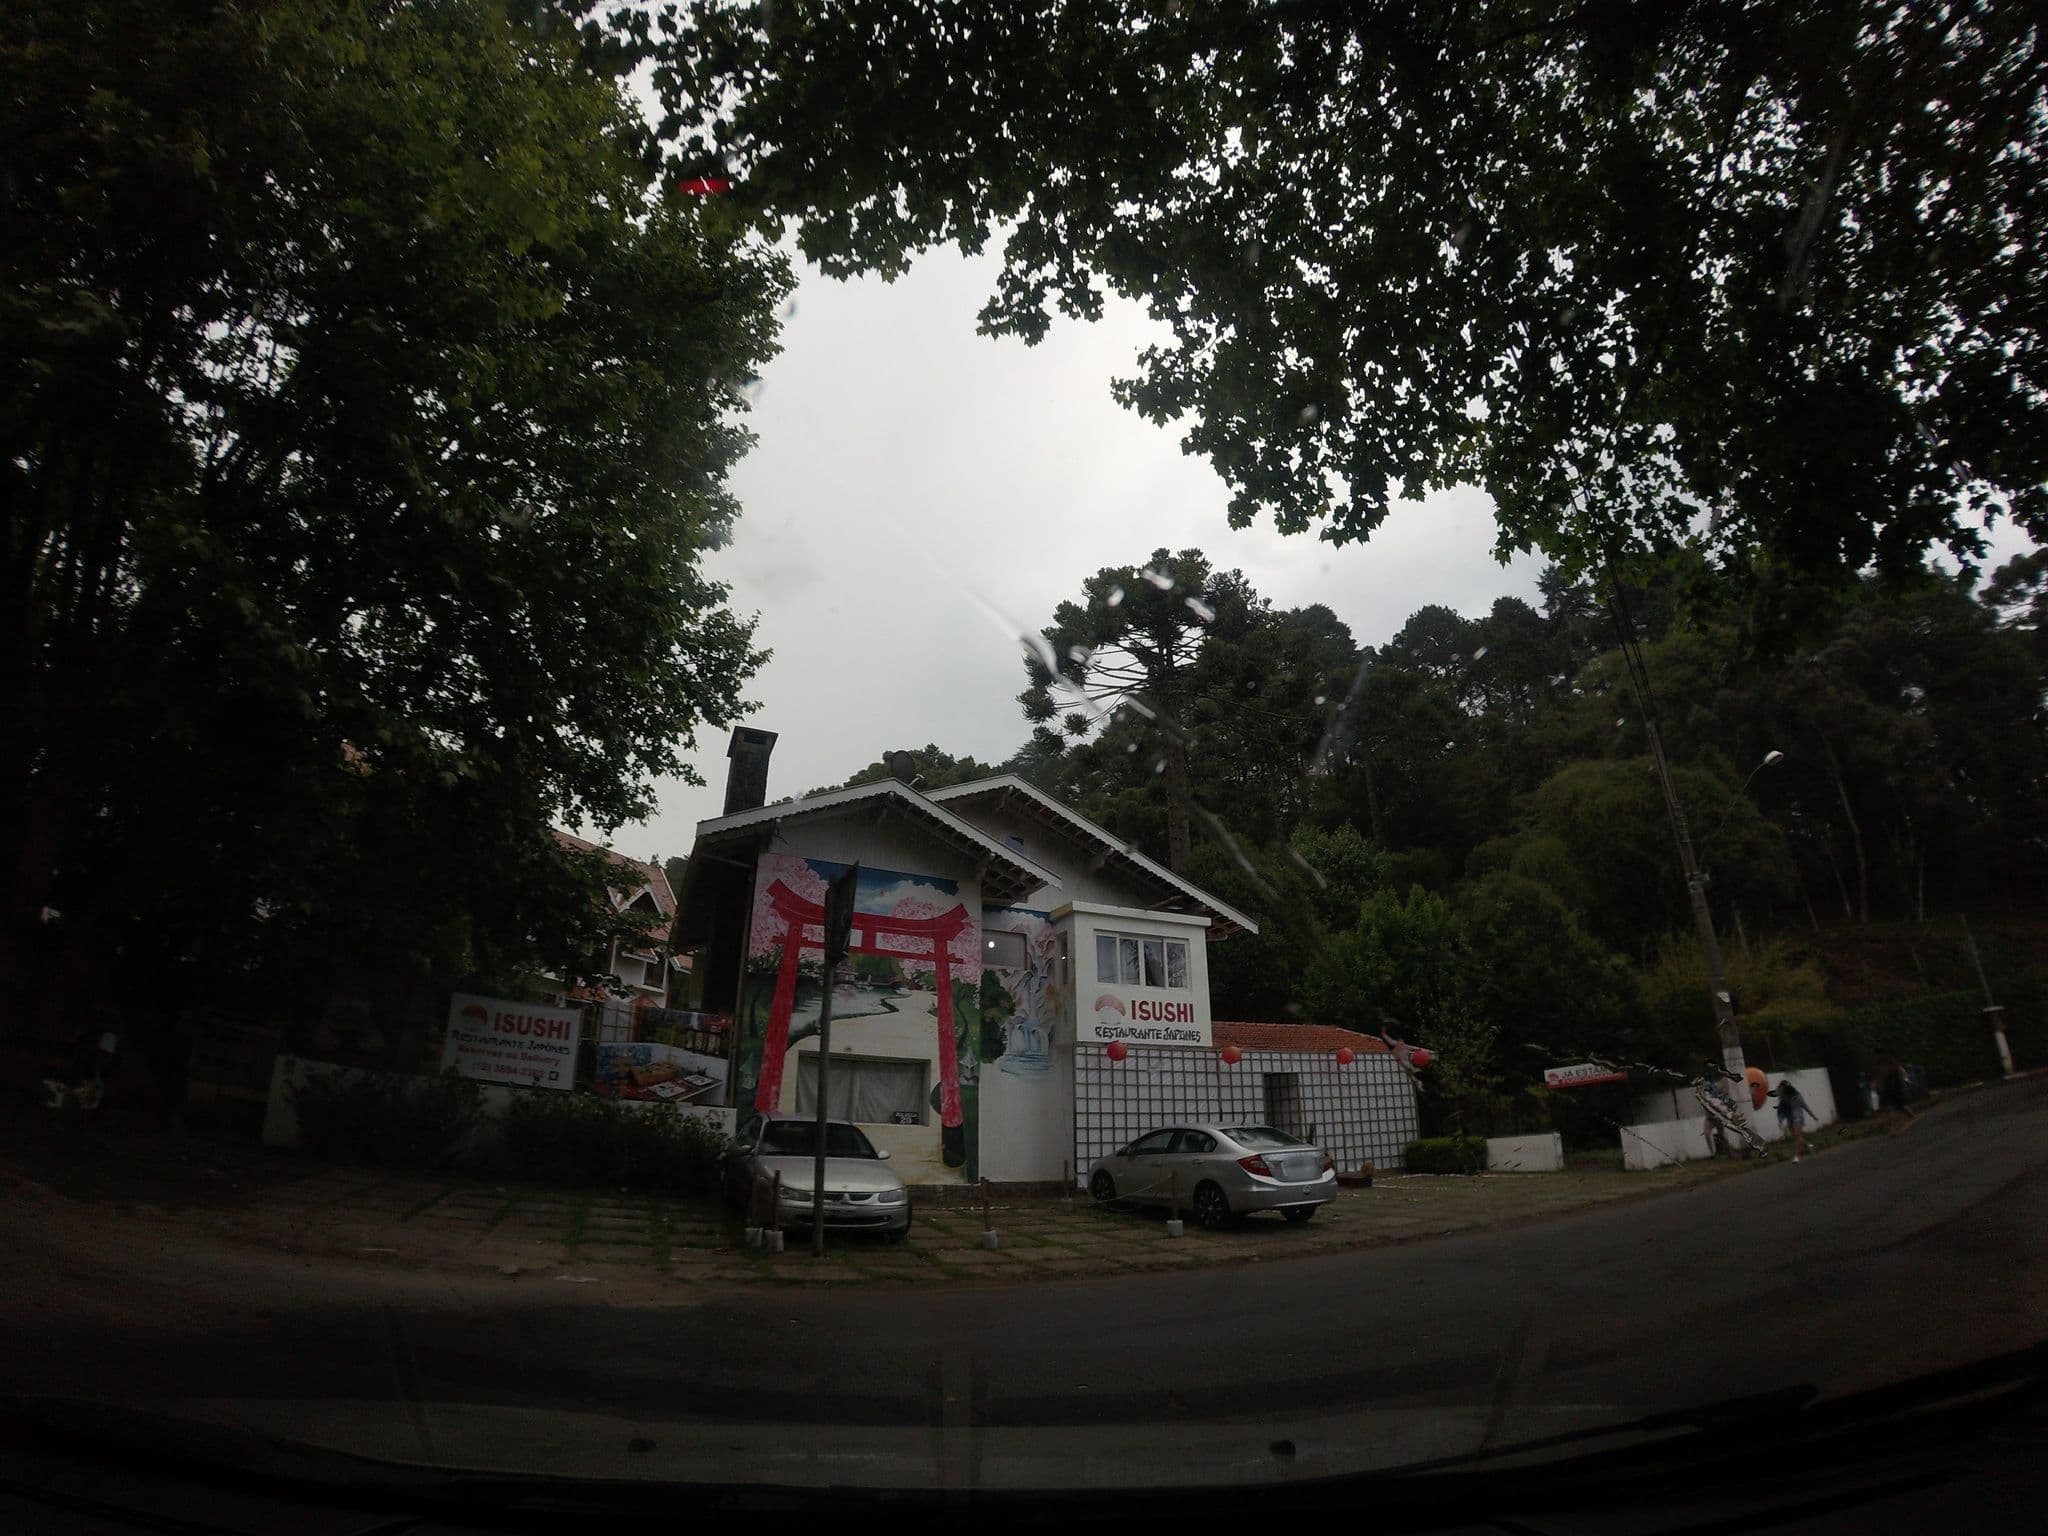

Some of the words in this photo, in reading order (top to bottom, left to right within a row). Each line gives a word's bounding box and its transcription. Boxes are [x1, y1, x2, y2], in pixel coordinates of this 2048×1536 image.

[1131, 1000, 1194, 1023] ISUSHI
[493, 1012, 571, 1040] ISUSHI
[1095, 1026, 1162, 1040] RESTAURANTE
[452, 1029, 525, 1049] RESTAURANTE
